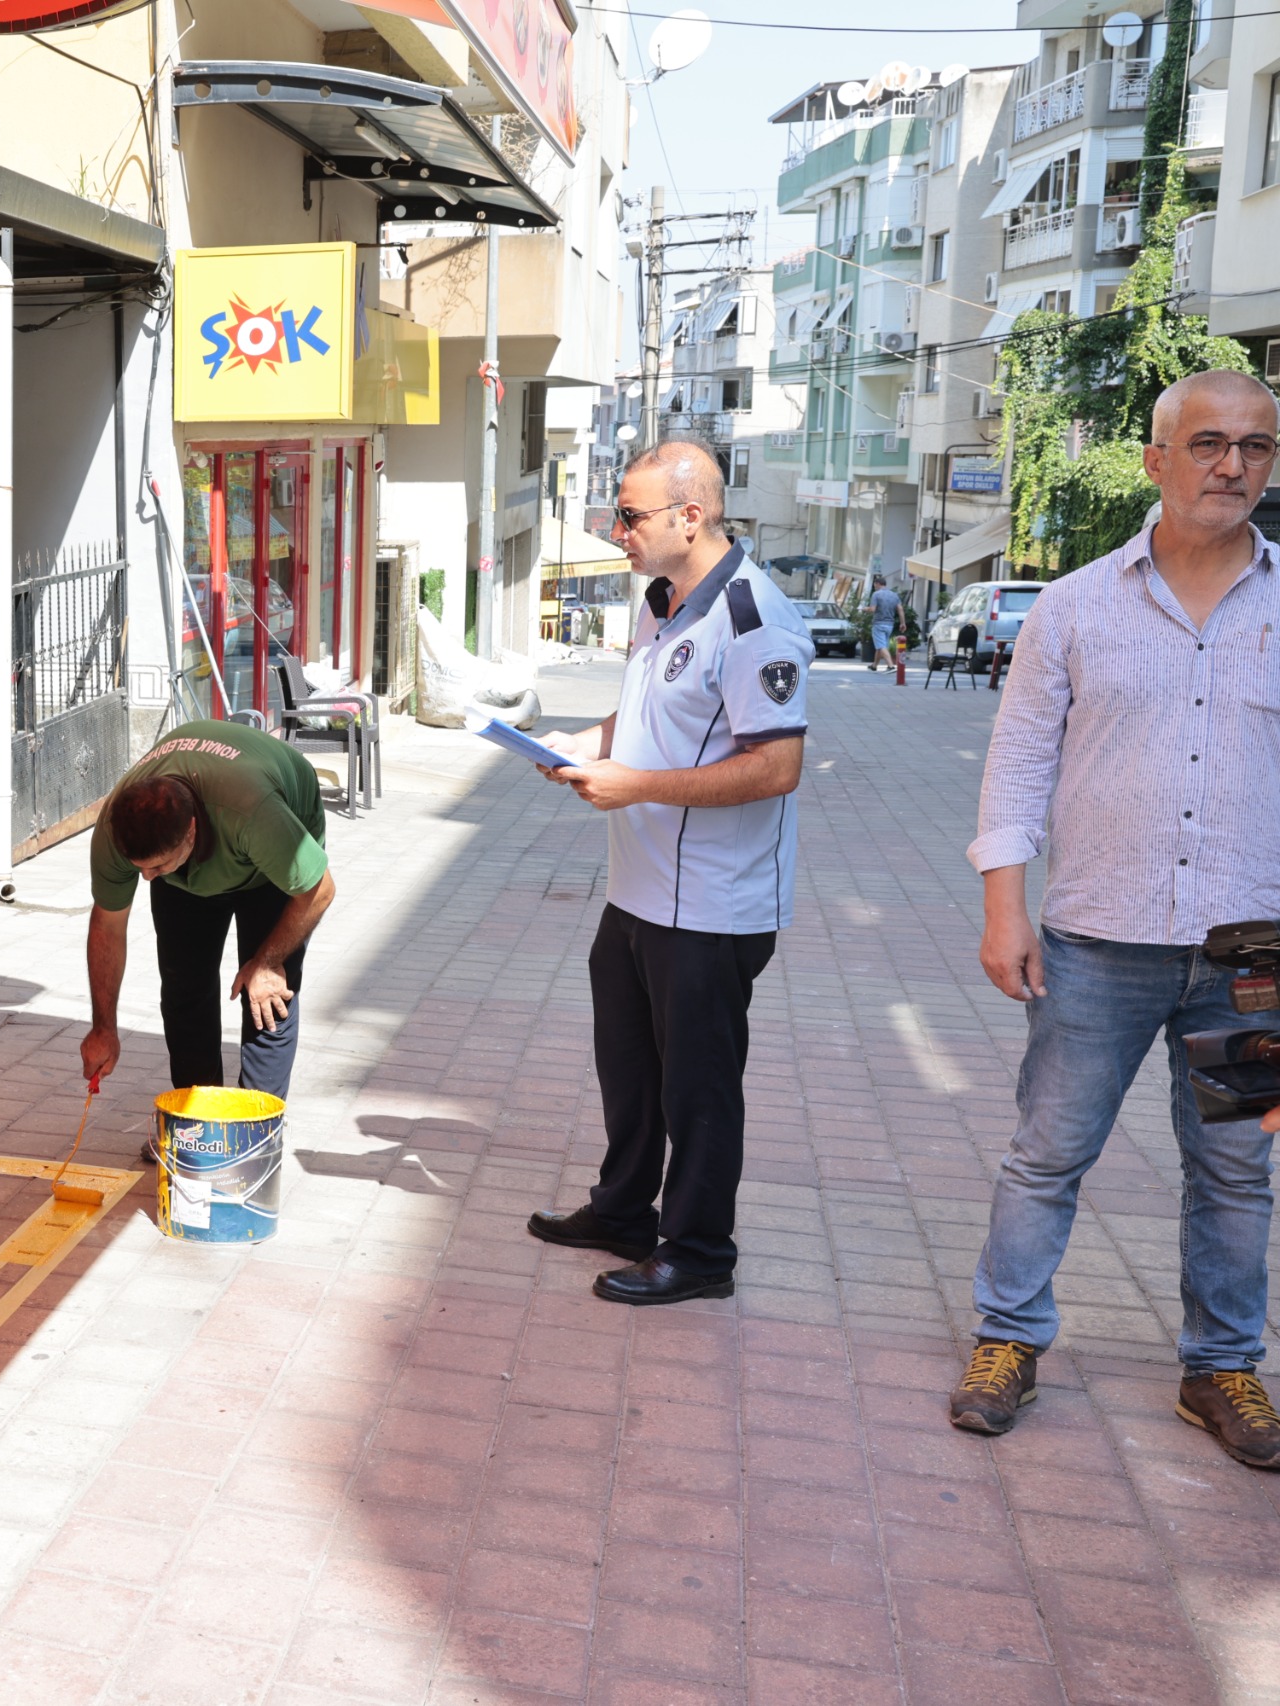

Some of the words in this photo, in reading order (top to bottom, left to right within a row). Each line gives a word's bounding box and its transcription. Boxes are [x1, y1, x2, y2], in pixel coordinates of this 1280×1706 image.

[200, 305, 331, 380] ŞOK
[196, 738, 241, 760] KONAK
[173, 1138, 223, 1154] melodi
